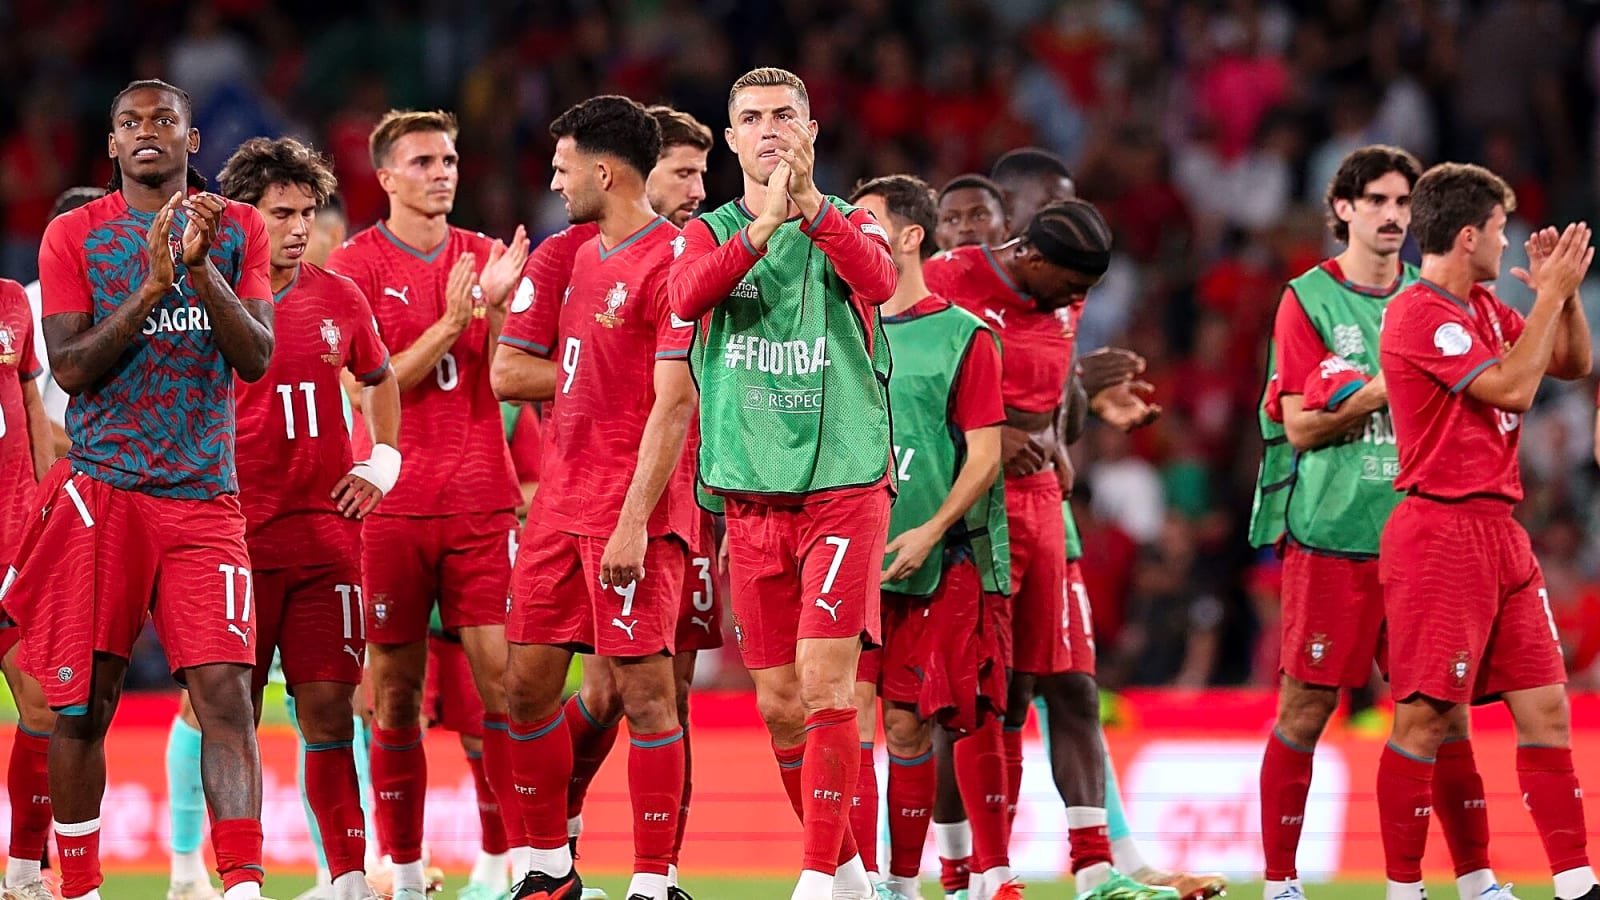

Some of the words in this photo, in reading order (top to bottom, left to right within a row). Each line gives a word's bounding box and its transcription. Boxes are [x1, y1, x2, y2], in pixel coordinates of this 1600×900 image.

[562, 336, 581, 394] 9
[724, 335, 832, 376] #FOOTBA
[277, 382, 319, 440] 11
[768, 392, 822, 410] RESPEC
[219, 563, 251, 622] 17
[692, 556, 714, 612] 3
[825, 535, 851, 594] 7
[334, 584, 366, 640] 11
